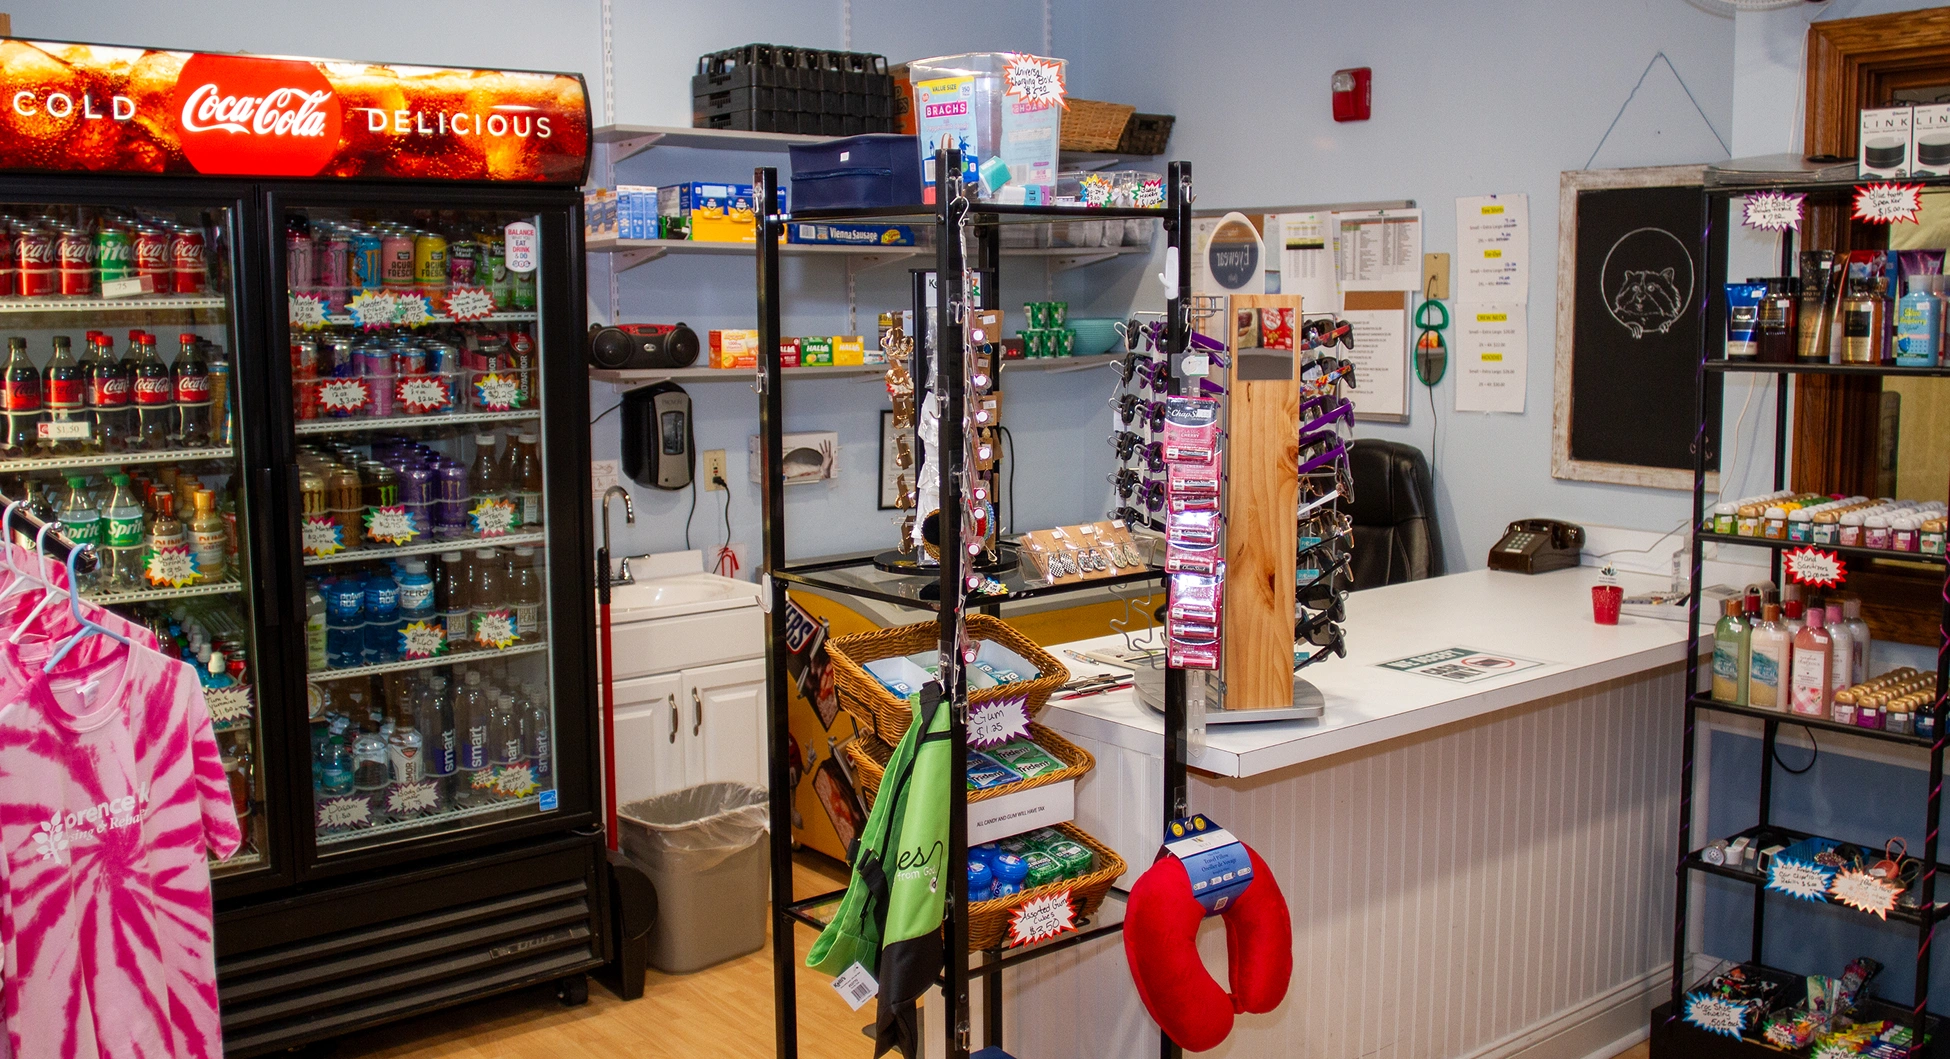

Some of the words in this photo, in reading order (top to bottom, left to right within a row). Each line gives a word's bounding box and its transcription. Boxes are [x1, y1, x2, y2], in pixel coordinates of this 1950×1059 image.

[13, 91, 136, 122] COLD
[181, 83, 333, 137] Coca-Cola
[926, 104, 966, 116] BRACHS
[367, 109, 552, 138] DELICIOUS
[1864, 118, 1908, 129] LINK
[1917, 115, 1948, 125] LIN
[830, 227, 852, 239] Vienna
[852, 230, 878, 242] Sausage
[56, 425, 80, 434] $1.50
[1797, 554, 1816, 562] Hand
[403, 589, 429, 597] ZERO
[973, 710, 1004, 726] Gum
[976, 723, 1004, 741] $1.25
[442, 730, 453, 772] smart
[469, 726, 482, 767] smart
[997, 746, 1029, 758] Trident
[1017, 760, 1049, 773] Trident
[971, 771, 1004, 782] Trident
[328, 802, 358, 814] Dasani
[984, 818, 997, 826] CANDY
[898, 870, 920, 881] from
[1020, 903, 1050, 923] Assorted
[1695, 1002, 1712, 1011] Croc
[1714, 1003, 1731, 1012] Shoe
[1702, 1010, 1731, 1020] Jewelry
